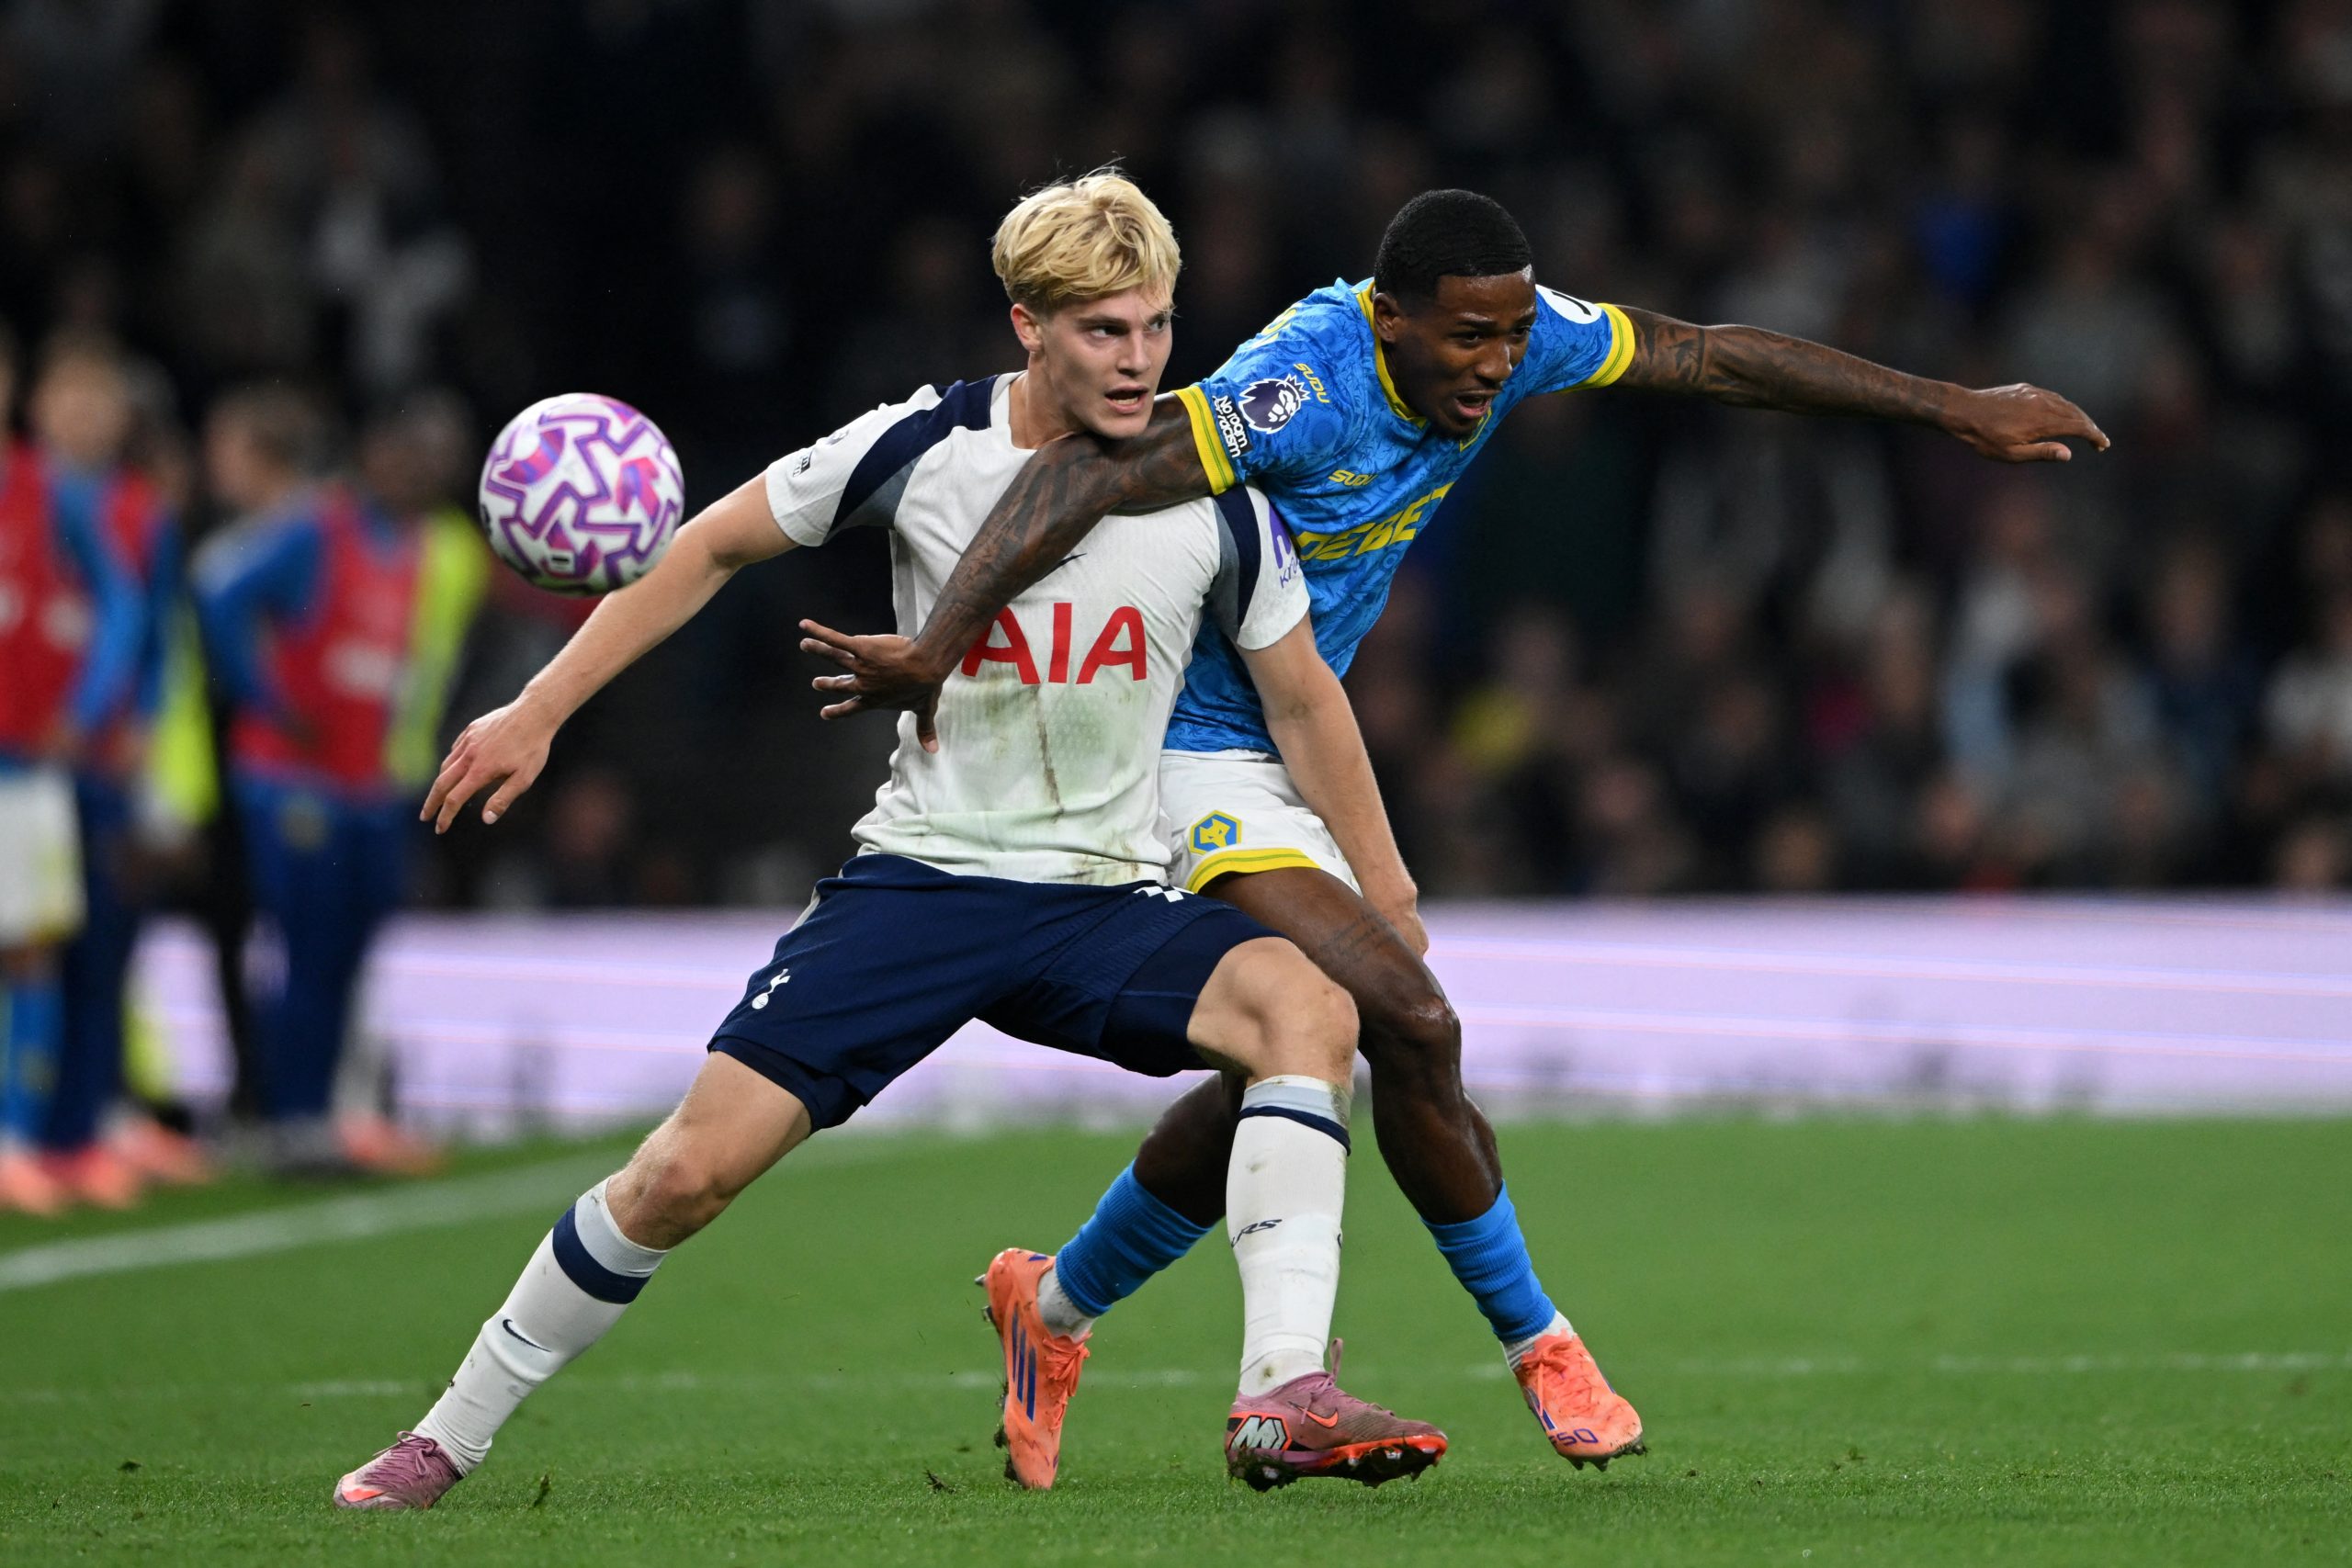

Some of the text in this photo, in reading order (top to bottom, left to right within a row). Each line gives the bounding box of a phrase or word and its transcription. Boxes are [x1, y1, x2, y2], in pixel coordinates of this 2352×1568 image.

[1294, 363, 1330, 403] SUDU
[1216, 395, 1248, 447] No room
[1217, 415, 1241, 457] racism
[961, 603, 1147, 684] AIA
